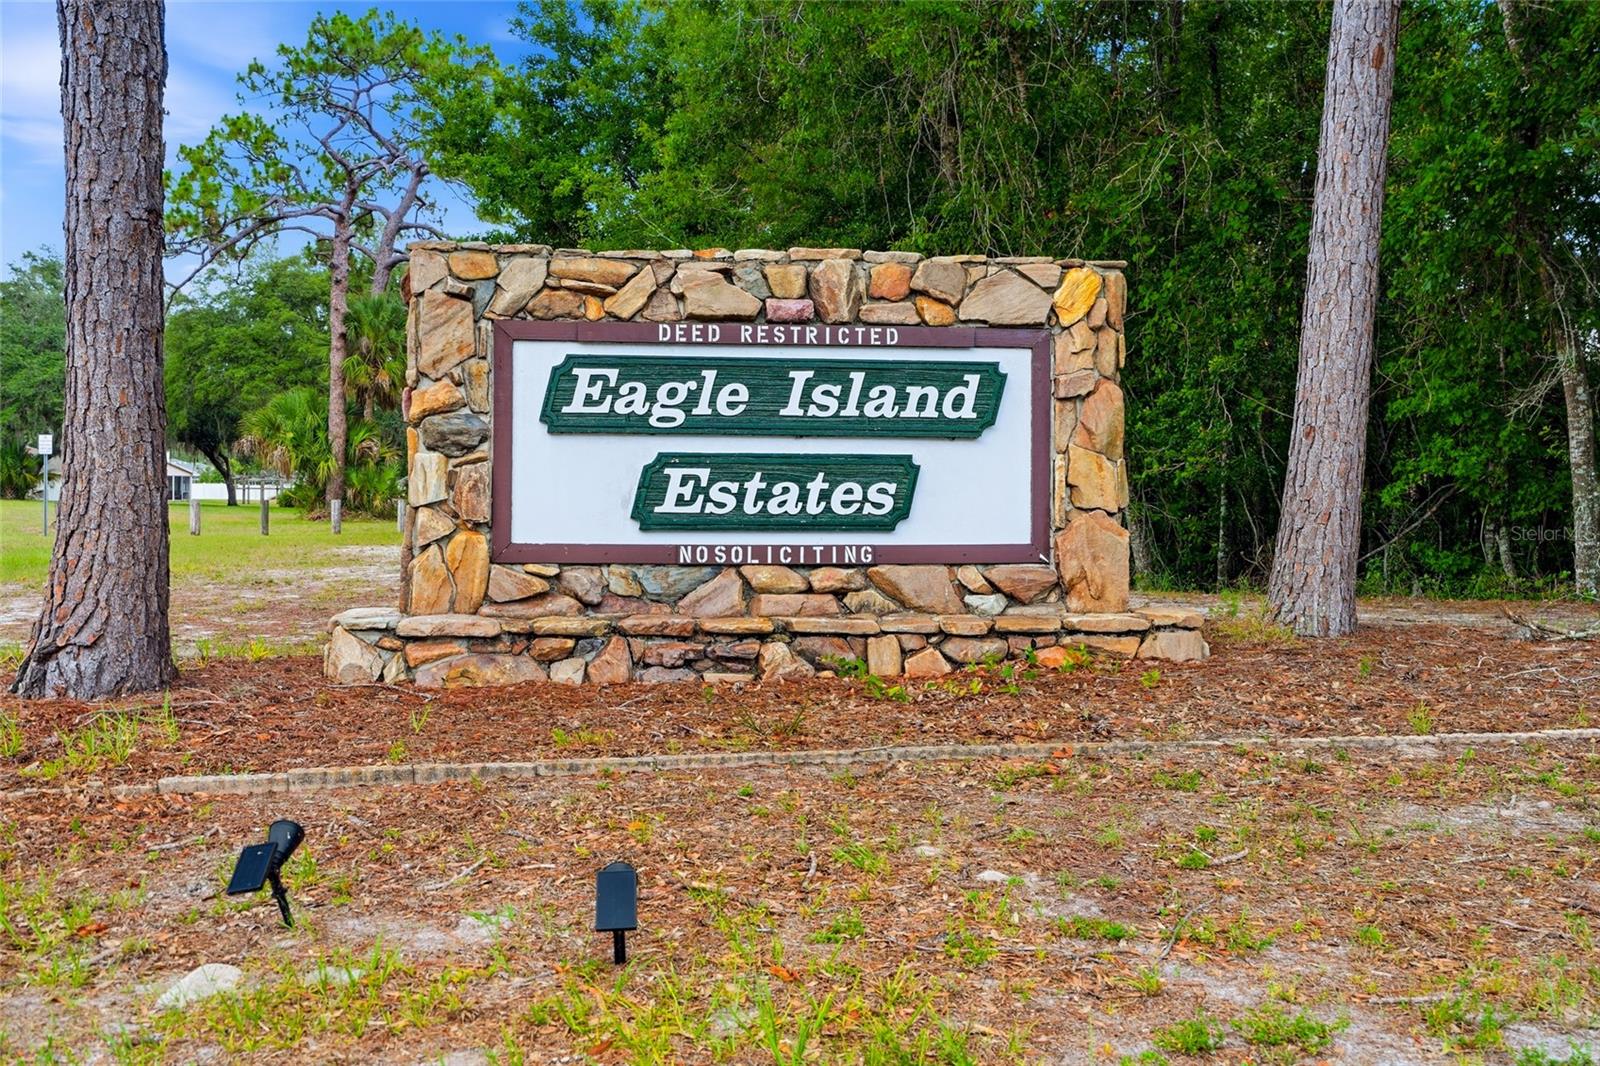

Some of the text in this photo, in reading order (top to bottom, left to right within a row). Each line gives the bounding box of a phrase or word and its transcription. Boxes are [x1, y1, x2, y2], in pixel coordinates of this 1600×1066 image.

[659, 323, 899, 345] DEED RESTRICTED
[561, 367, 981, 428] Eagle Island
[654, 467, 897, 515] Estates
